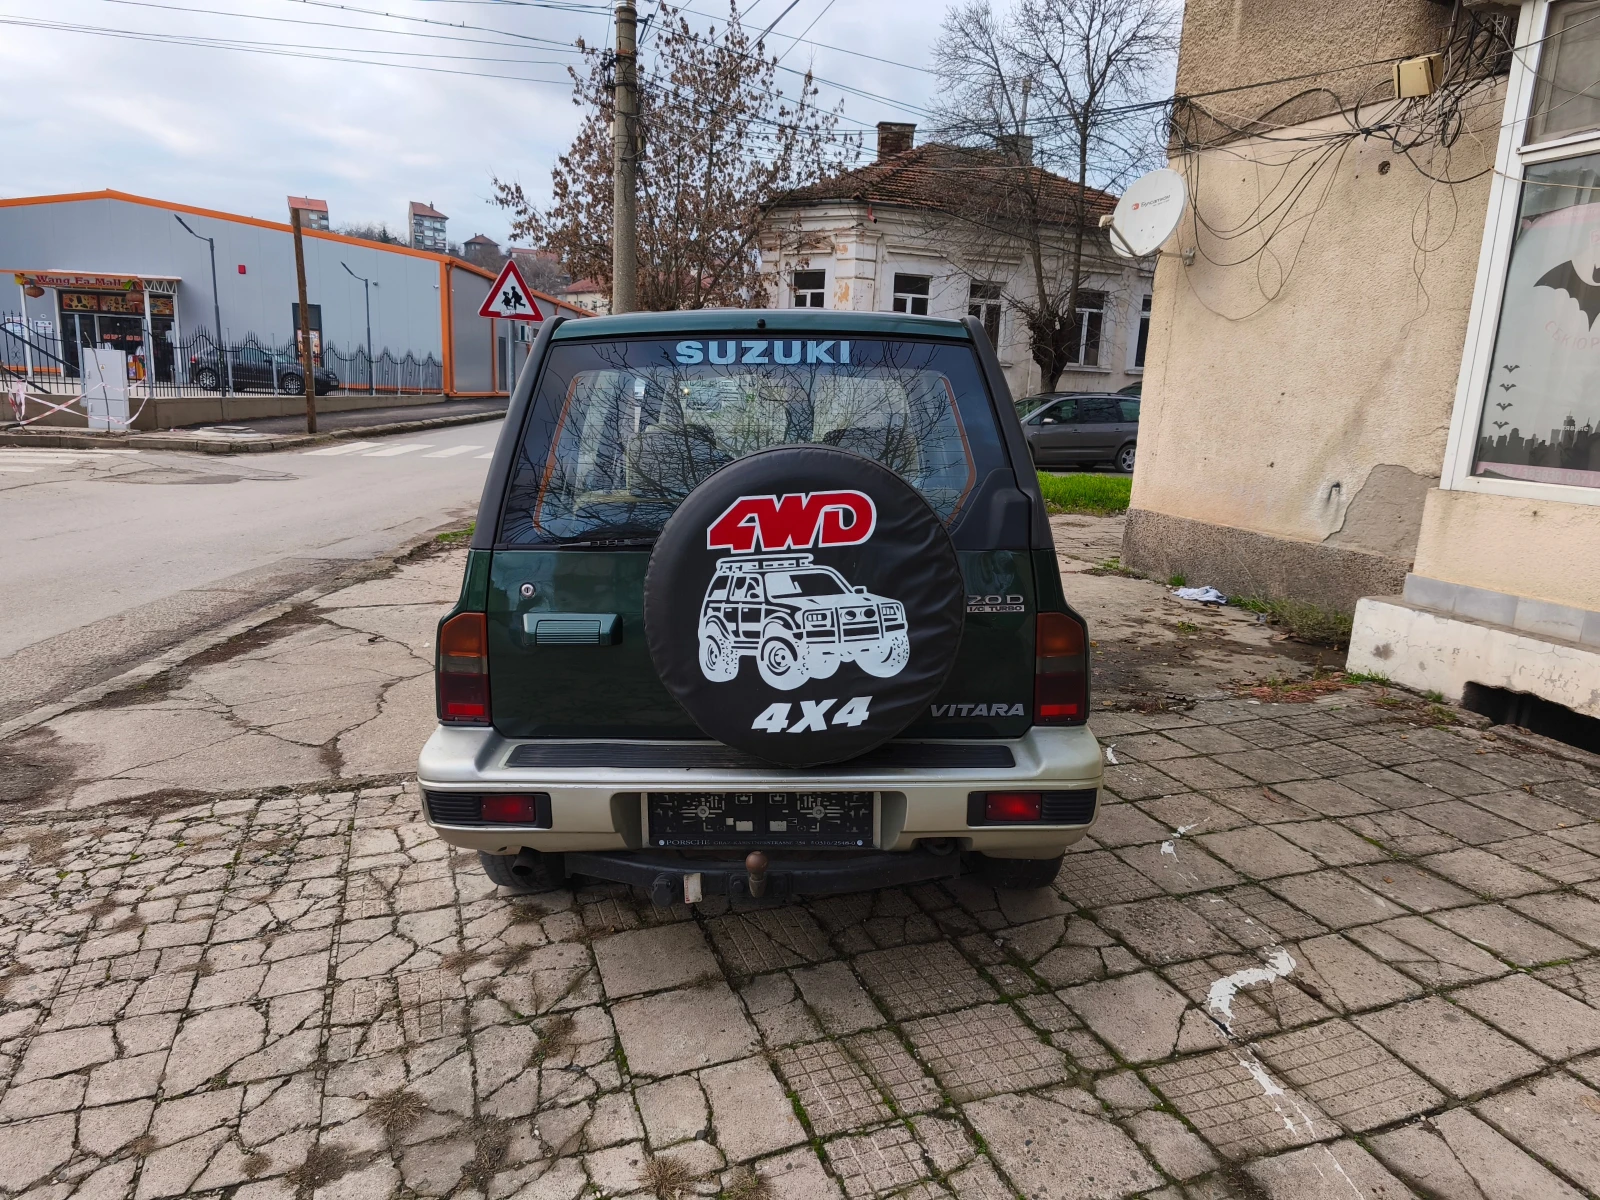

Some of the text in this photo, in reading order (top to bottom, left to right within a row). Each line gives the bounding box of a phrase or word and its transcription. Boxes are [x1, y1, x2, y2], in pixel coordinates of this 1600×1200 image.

[36, 275, 121, 287] Wang Fa Mall
[676, 340, 850, 365] SUZUKI
[707, 489, 877, 554] 4WD
[968, 594, 1024, 605] 2.0 D
[751, 696, 873, 733] 4X4
[930, 703, 1025, 717] VITARA
